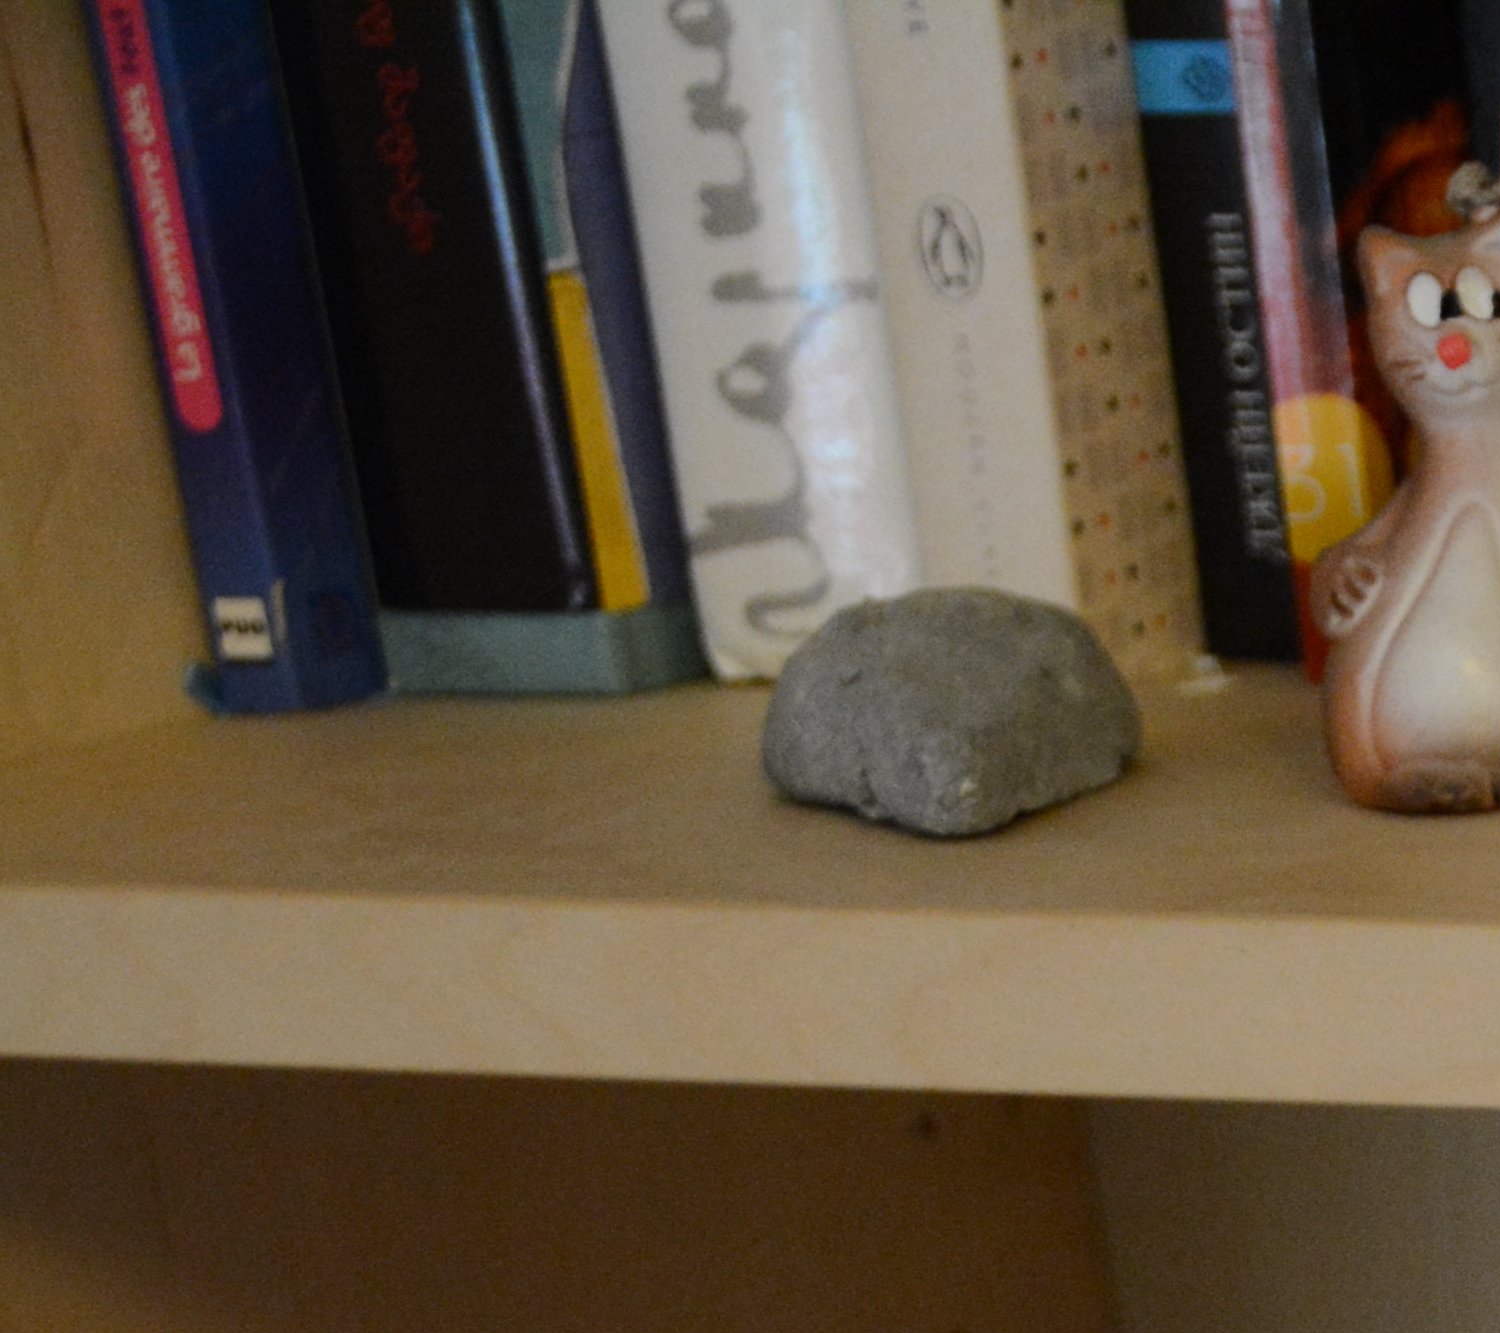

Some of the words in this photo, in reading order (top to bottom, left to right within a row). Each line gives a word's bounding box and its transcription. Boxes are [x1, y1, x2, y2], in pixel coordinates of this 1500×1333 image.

[173, 340, 203, 383] La
[1205, 209, 1261, 385] ОСТИН
[1226, 390, 1289, 562] ДЖЕЙН
